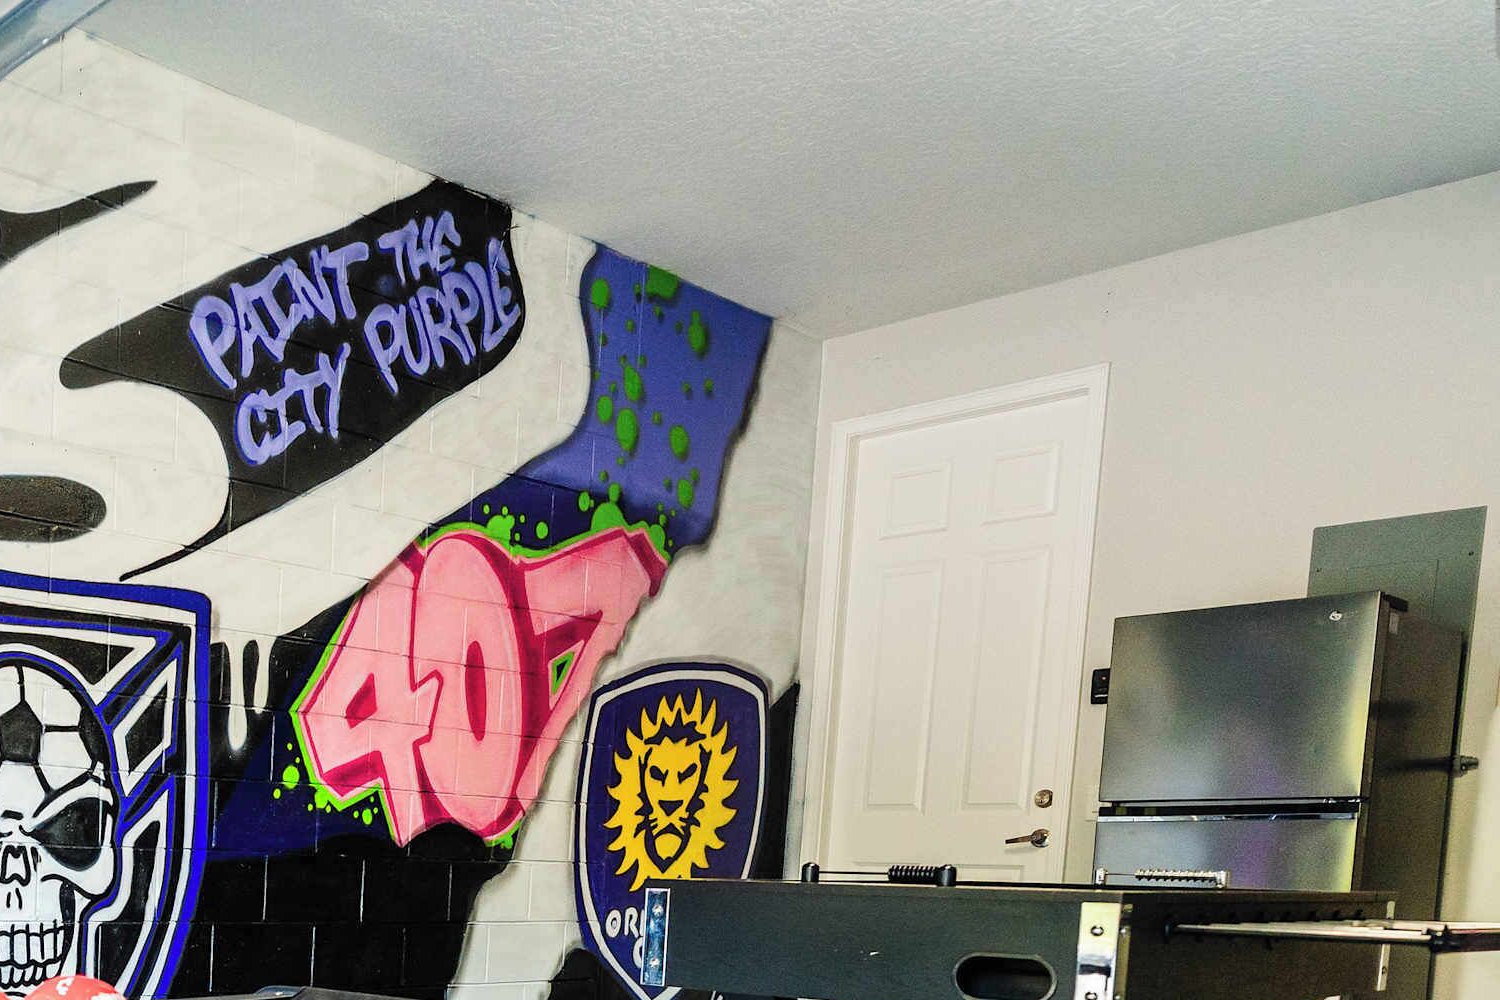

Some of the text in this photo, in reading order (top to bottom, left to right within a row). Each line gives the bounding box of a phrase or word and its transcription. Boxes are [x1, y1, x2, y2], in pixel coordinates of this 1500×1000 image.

[187, 210, 461, 389] PAINT THE
[234, 237, 521, 466] CITY PURPLE
[292, 526, 670, 848] 407
